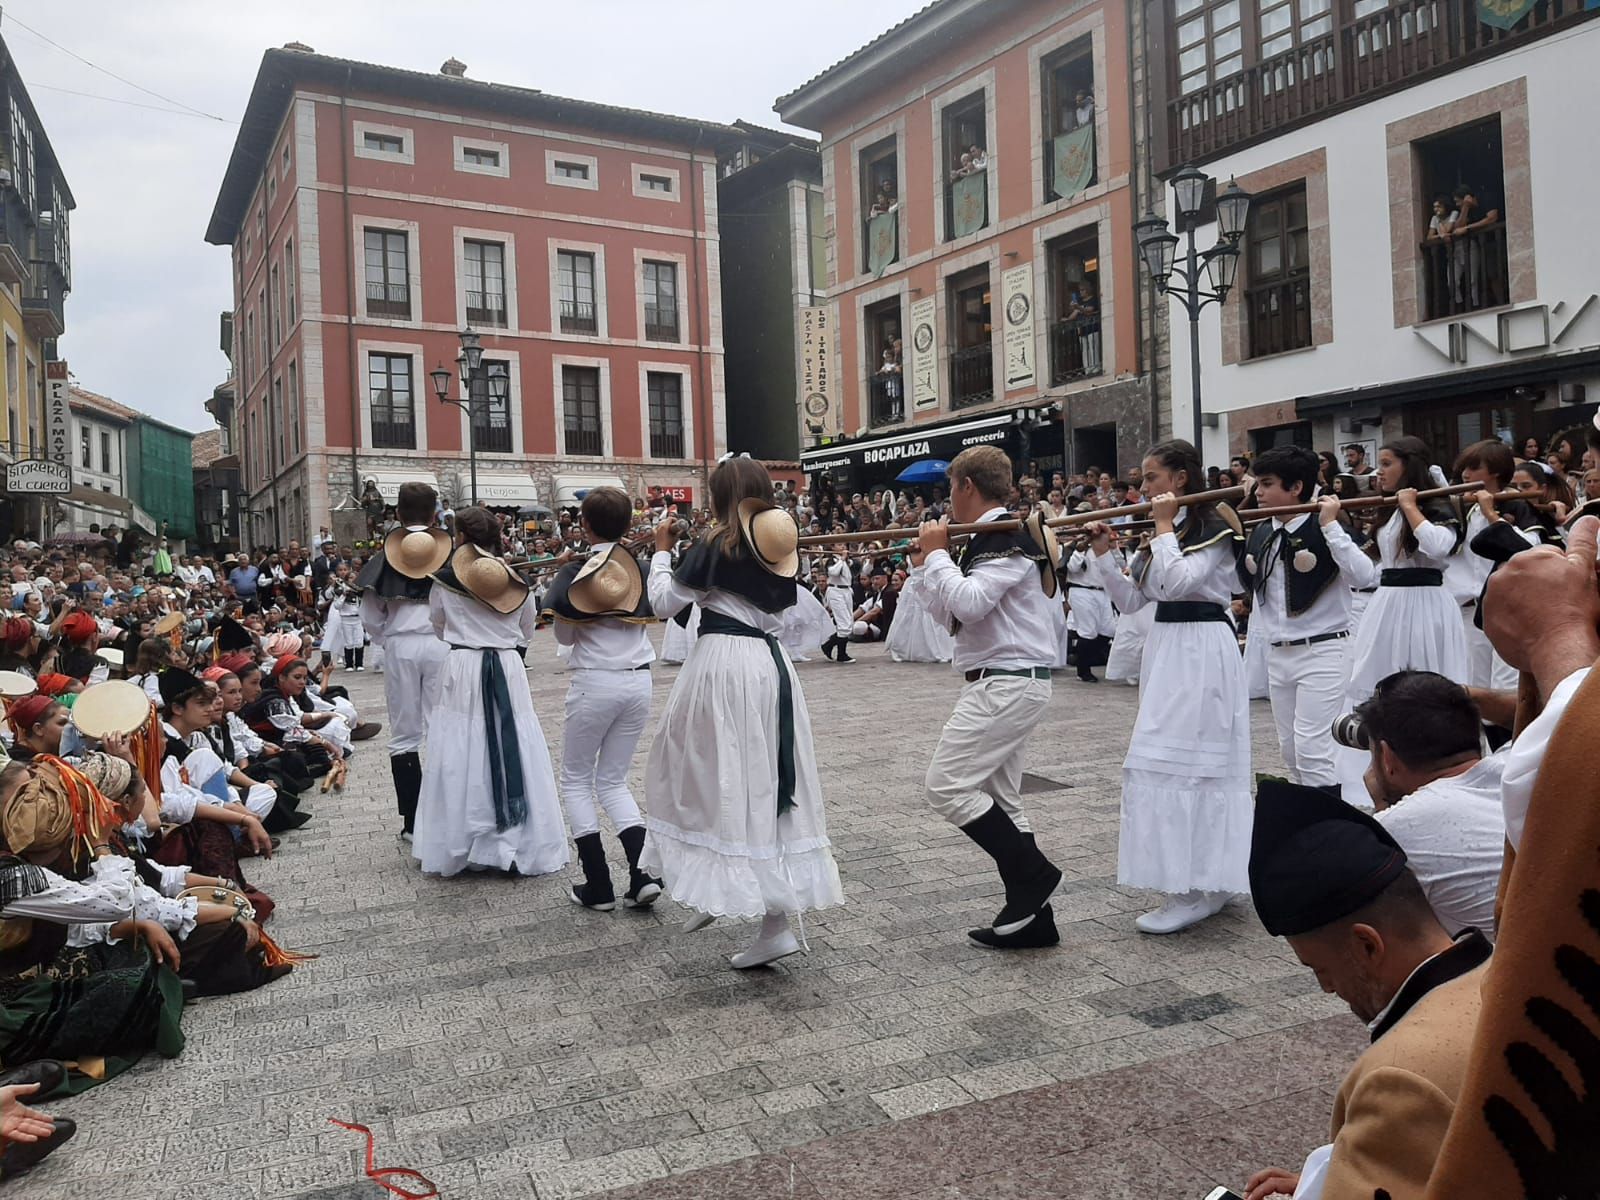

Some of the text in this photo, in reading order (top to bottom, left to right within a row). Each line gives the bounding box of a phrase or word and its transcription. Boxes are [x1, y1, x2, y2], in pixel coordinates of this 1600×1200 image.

[818, 336, 826, 392] ITALIANOS
[52, 383, 63, 423] PLAZA
[1276, 409, 1283, 419] 6
[53, 428, 65, 465] MAYO
[864, 441, 930, 464] BOCAPLAZA
[962, 430, 1005, 445] cervecería
